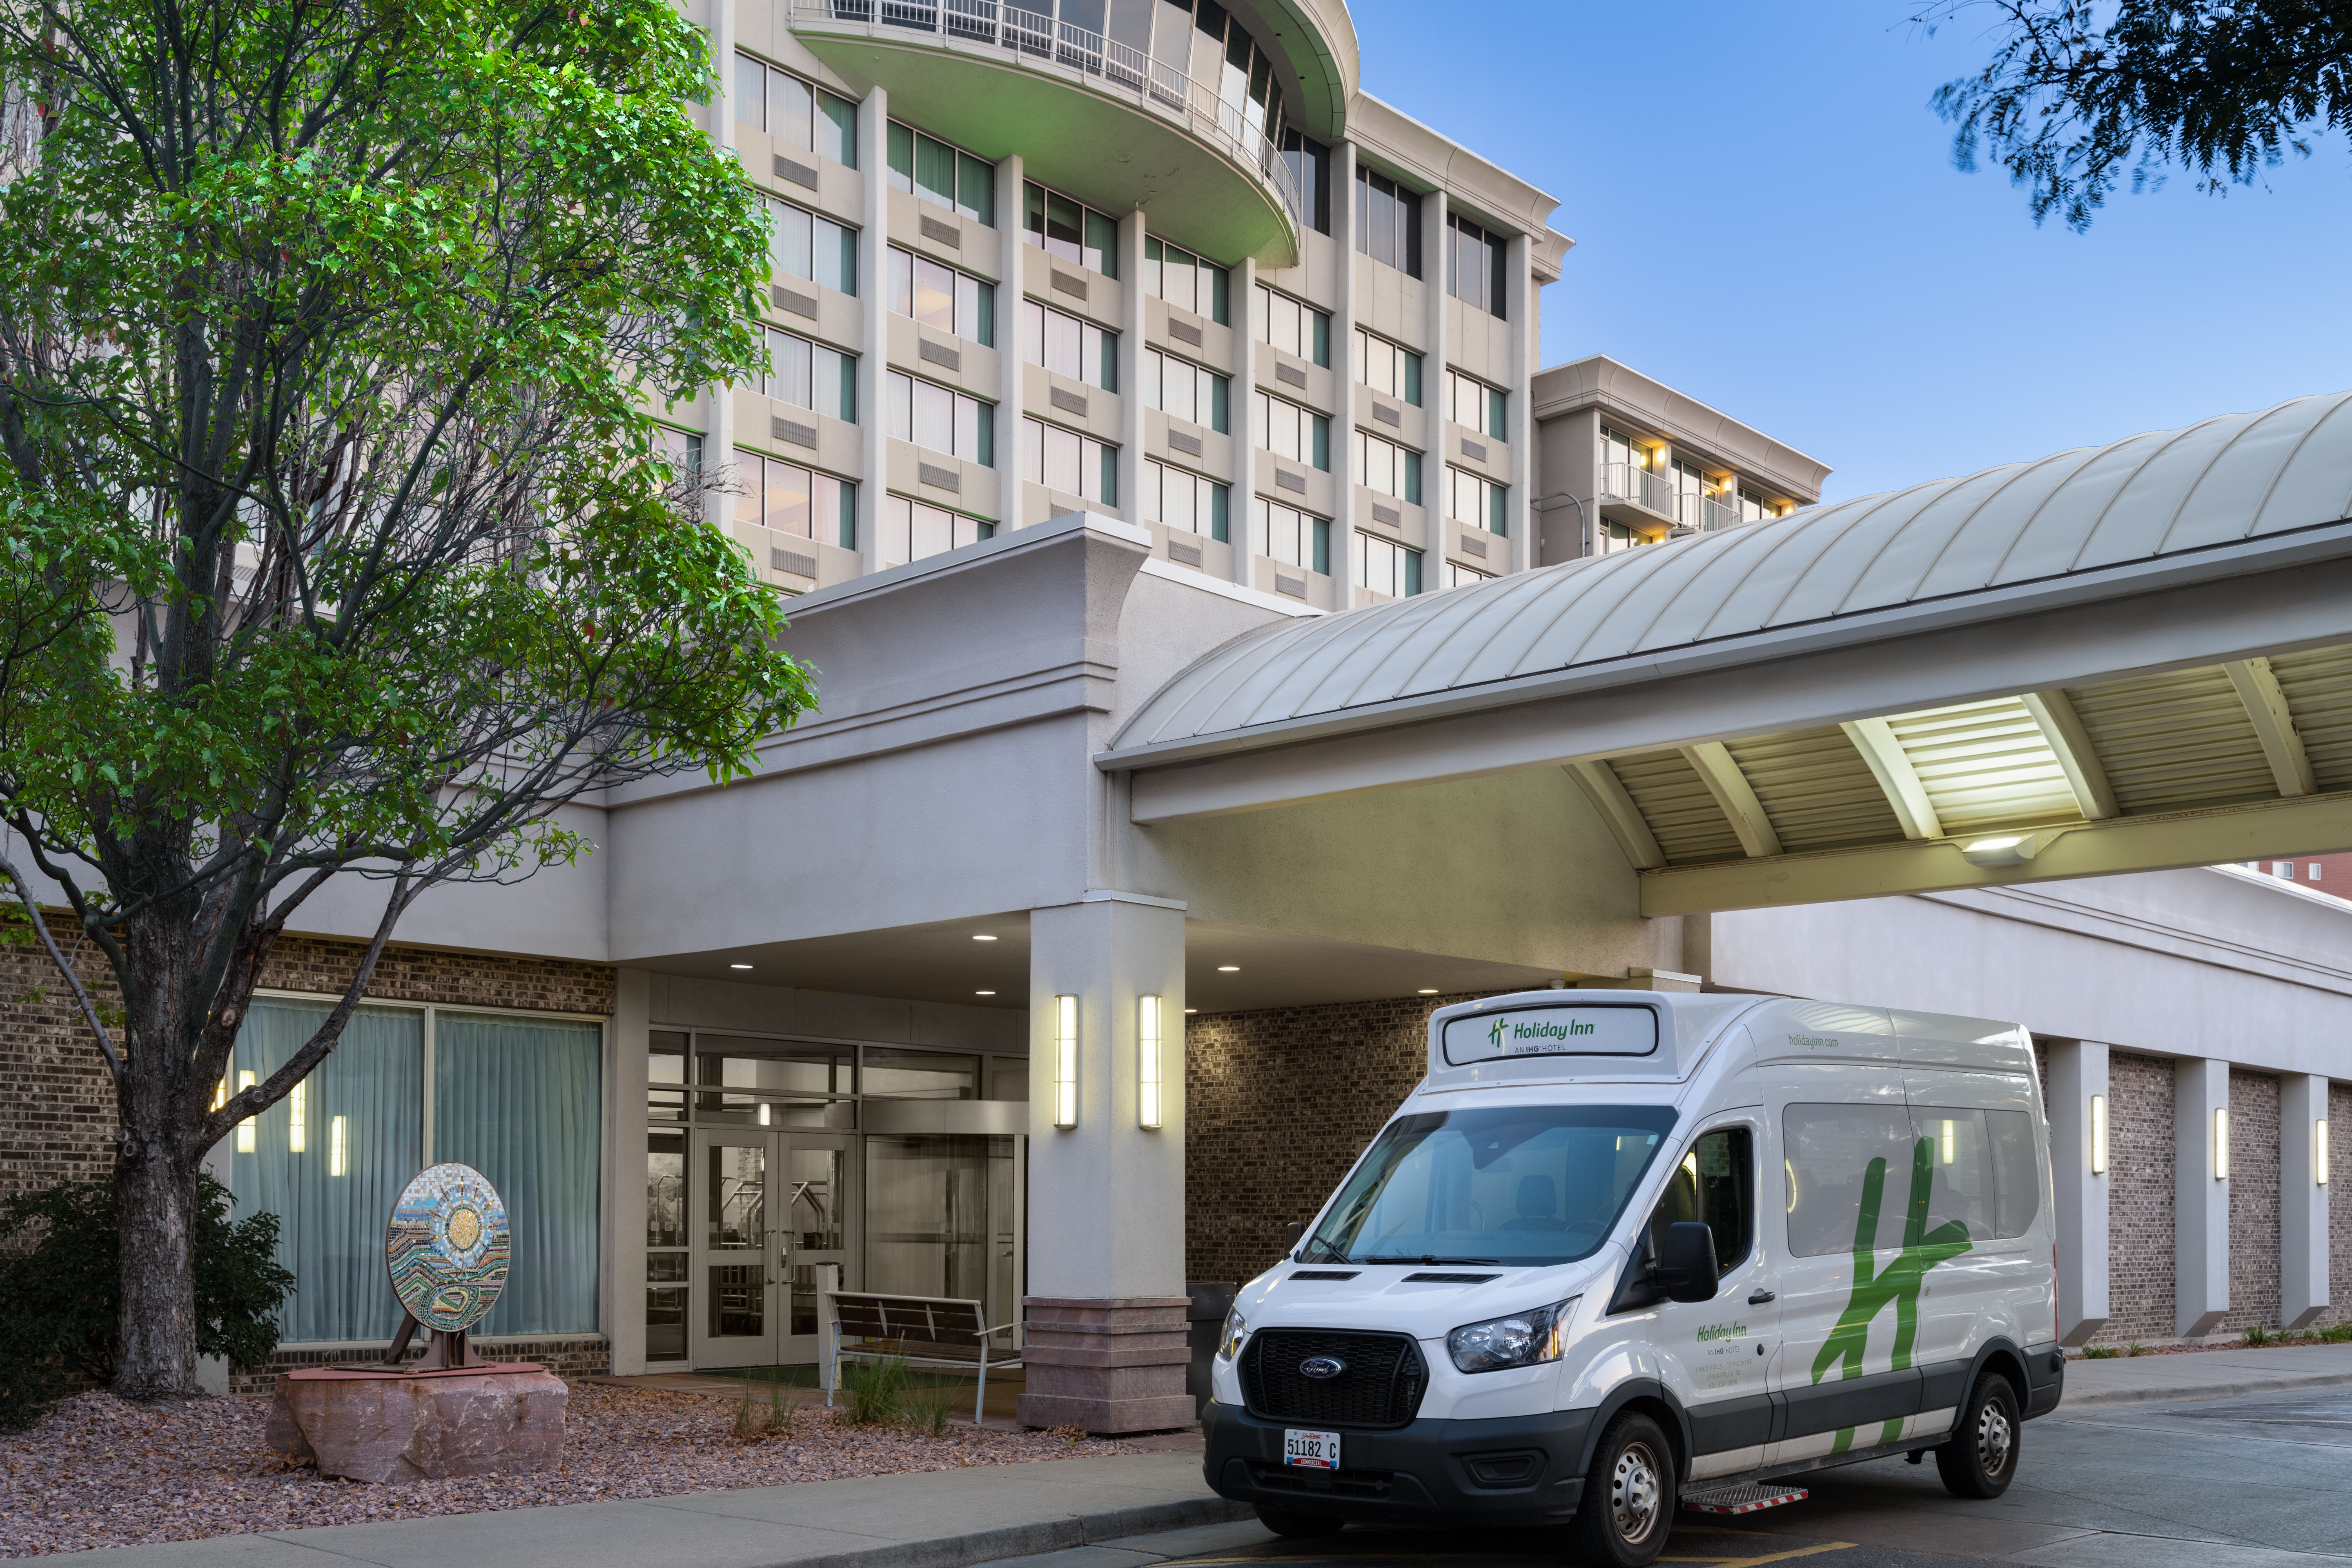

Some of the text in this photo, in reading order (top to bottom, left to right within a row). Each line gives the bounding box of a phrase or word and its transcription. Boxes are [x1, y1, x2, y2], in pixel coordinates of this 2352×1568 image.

[1514, 1019, 1594, 1040] Holiday Inn
[1697, 1321, 1746, 1343] Holiday Inn
[1307, 1361, 1330, 1374] Ford
[1709, 1379, 1737, 1389] 605-339-2000
[1288, 1439, 1336, 1459] 51182 C
